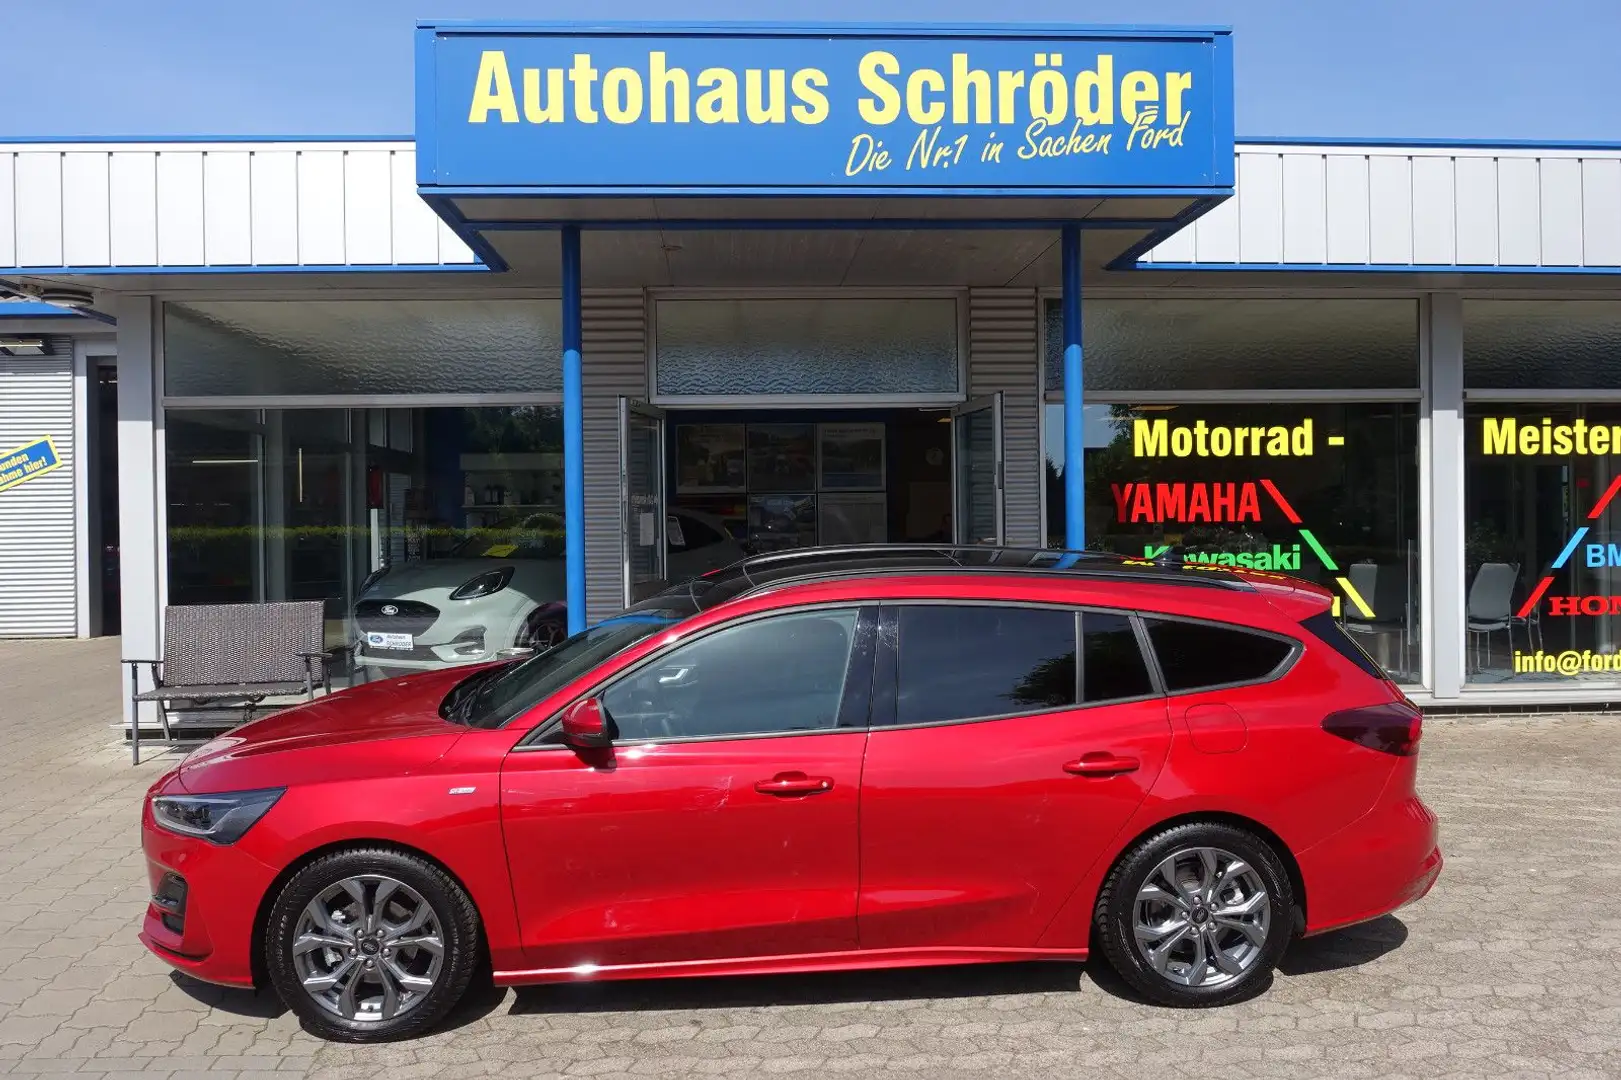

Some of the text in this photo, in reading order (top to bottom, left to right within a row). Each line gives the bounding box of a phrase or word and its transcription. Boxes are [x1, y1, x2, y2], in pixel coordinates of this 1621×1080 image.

[469, 51, 1192, 125] Autohaus Schröder
[845, 106, 1191, 176] Die Nr.1 in Sachen Ford
[1133, 418, 1314, 457] Motorrad
[1112, 482, 1262, 524] YAMAHA
